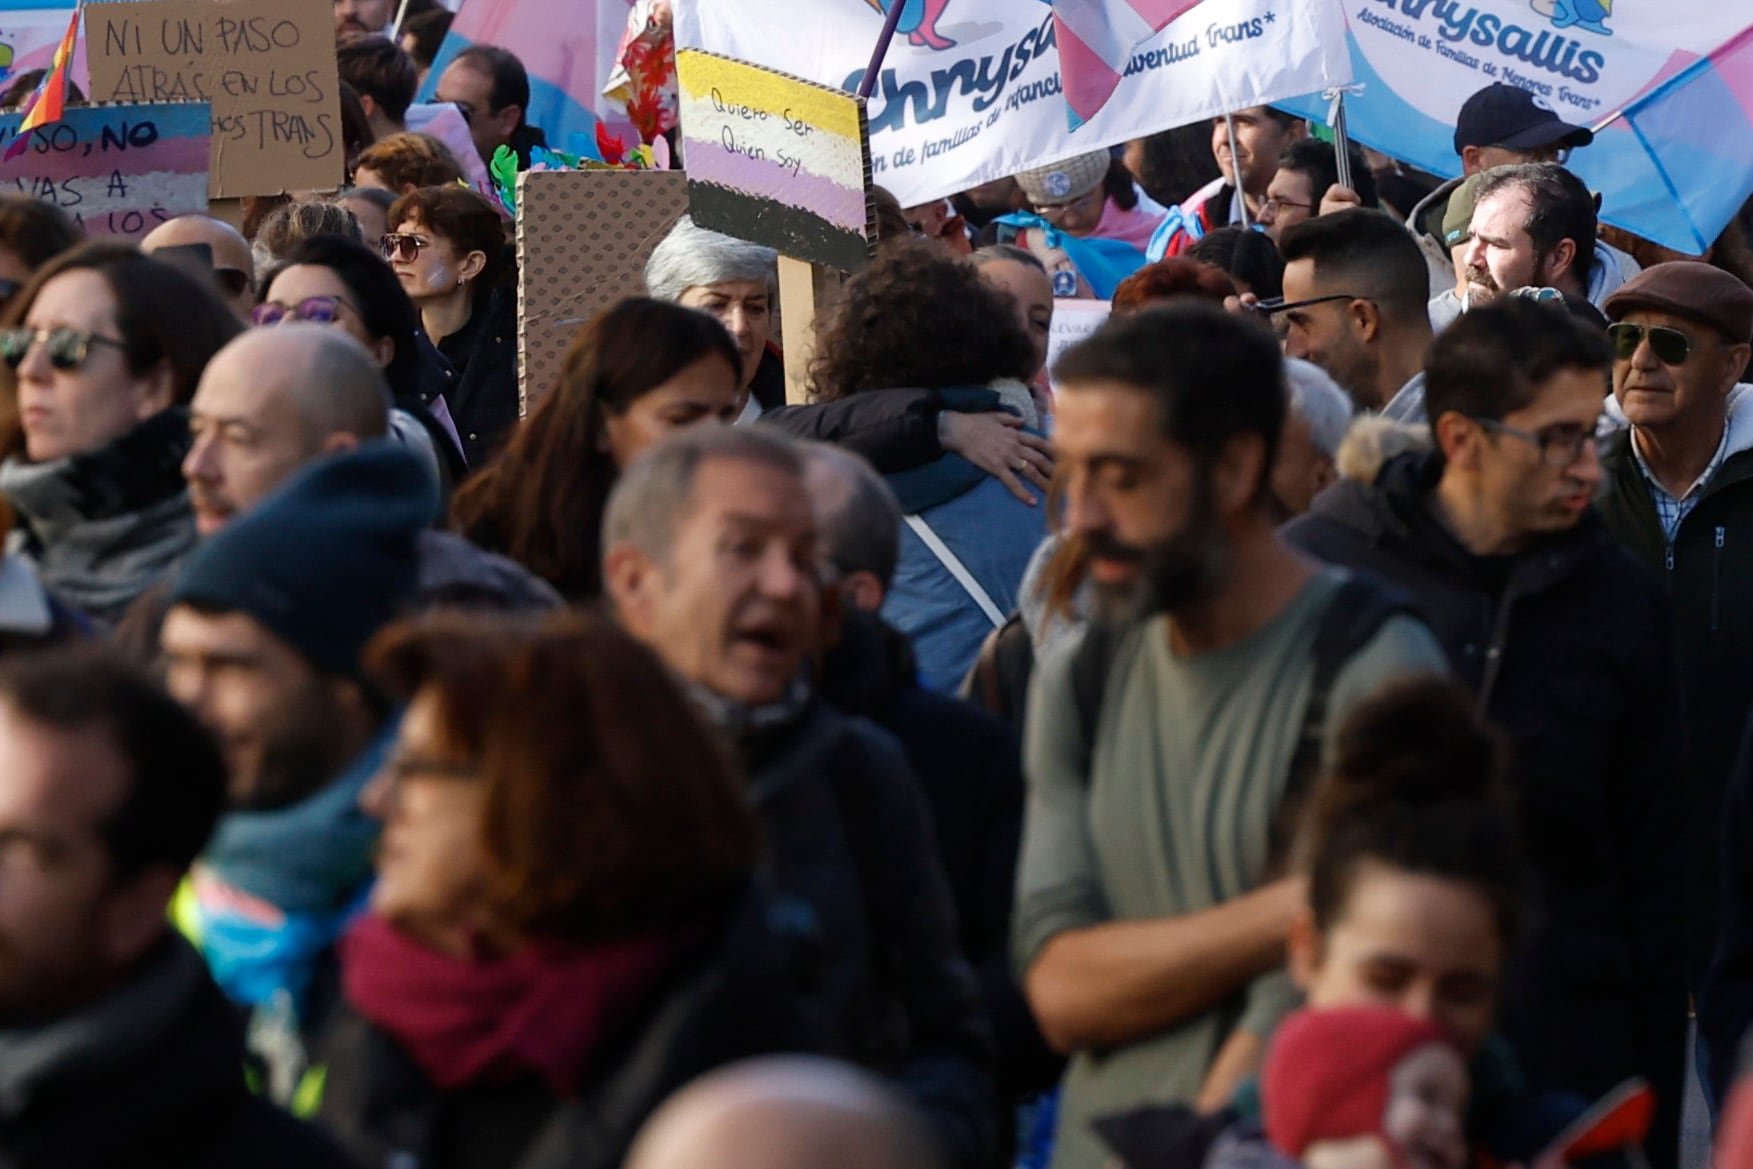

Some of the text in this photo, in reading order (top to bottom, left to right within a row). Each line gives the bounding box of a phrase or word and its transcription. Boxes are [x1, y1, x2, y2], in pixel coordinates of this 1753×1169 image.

[160, 18, 204, 57] UN
[215, 16, 301, 54] PASO
[1417, 34, 1433, 51] de
[1482, 62, 1498, 78] de
[221, 70, 258, 97] EN
[268, 69, 325, 104] LOS
[711, 87, 769, 121] Quiero
[101, 120, 160, 151] NO
[248, 110, 335, 159] TRANS
[721, 124, 766, 161] Quien
[892, 146, 916, 168] de
[106, 168, 129, 198] A
